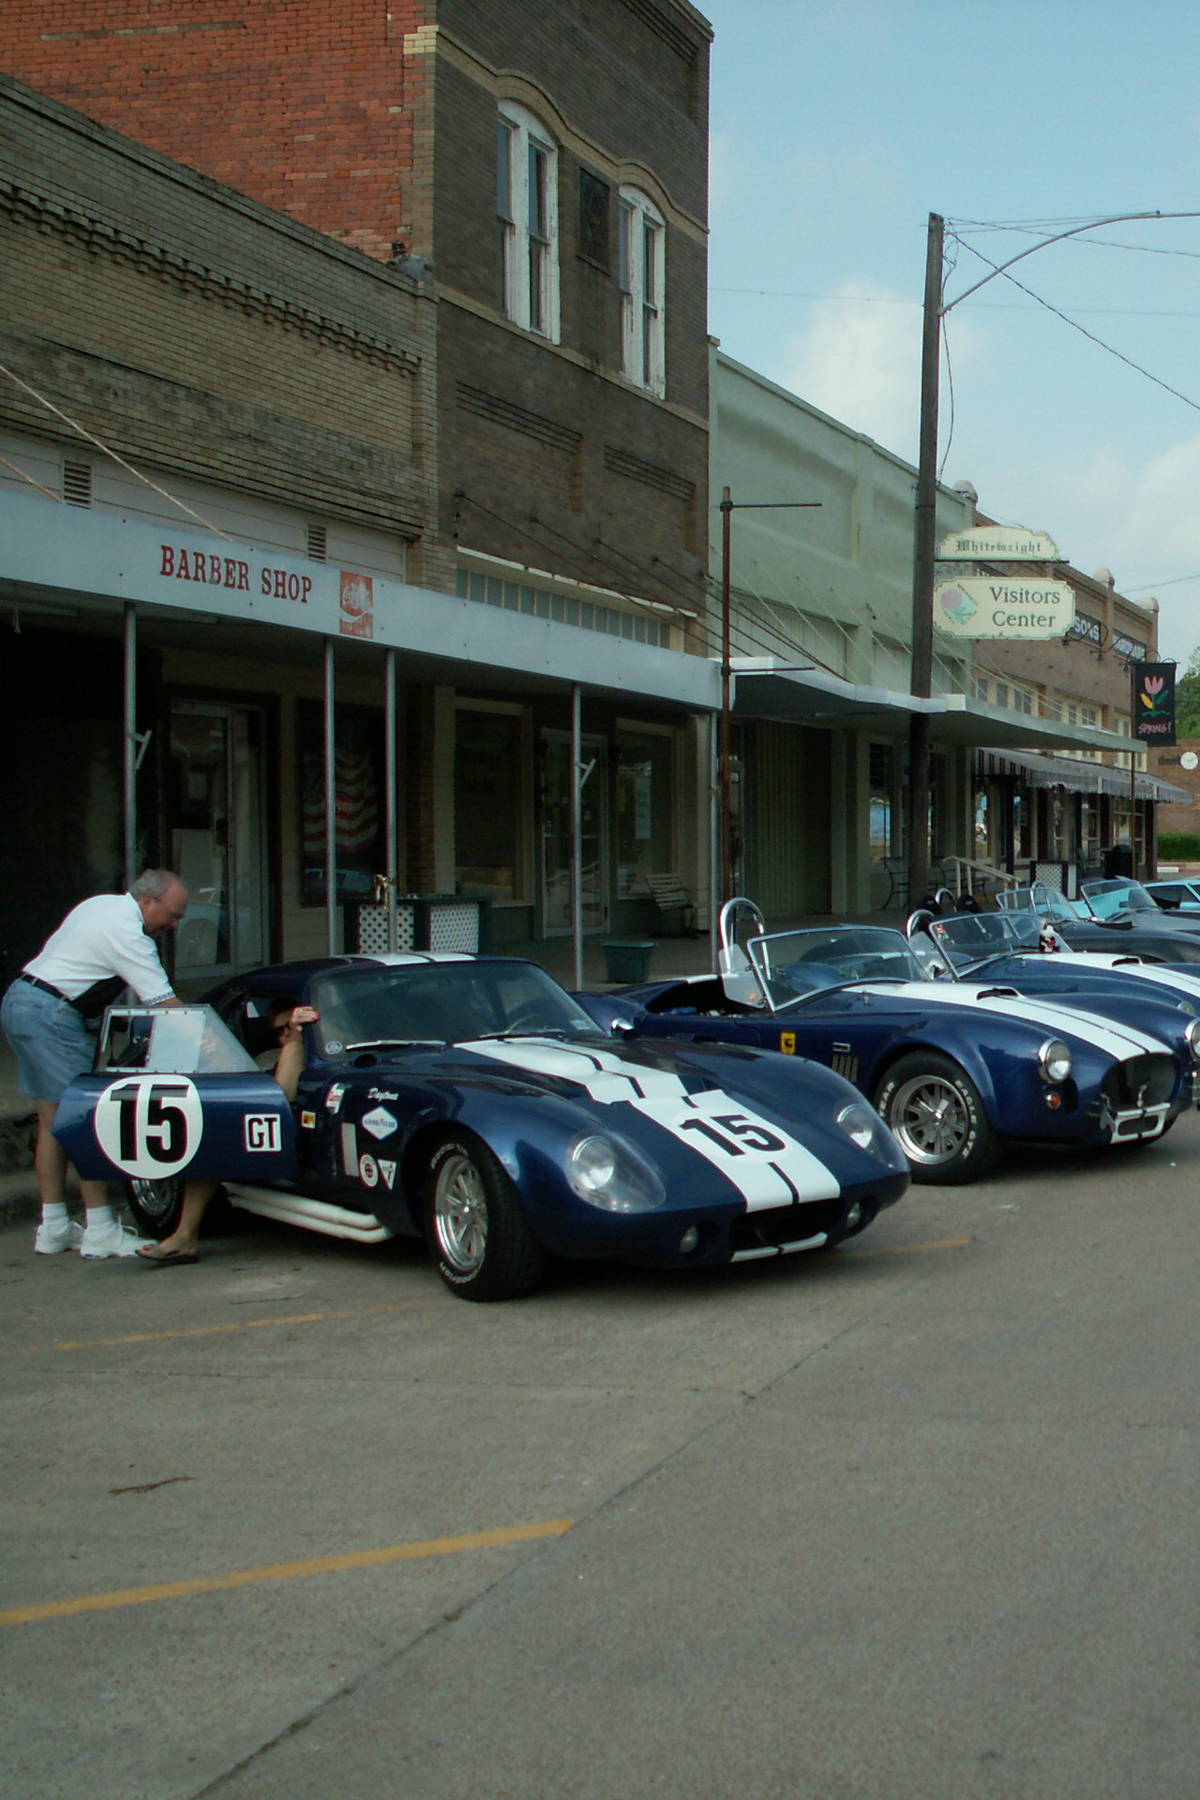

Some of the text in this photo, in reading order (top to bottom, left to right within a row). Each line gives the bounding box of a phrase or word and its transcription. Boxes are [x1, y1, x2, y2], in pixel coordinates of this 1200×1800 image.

[956, 540, 1042, 554] Whitewright
[160, 544, 250, 592] BARBER
[261, 567, 313, 604] SHOP
[989, 586, 1061, 604] Visitors
[992, 610, 1056, 629] Center
[110, 1083, 190, 1164] 15
[247, 1117, 278, 1149] GT
[679, 1114, 787, 1157] 15
